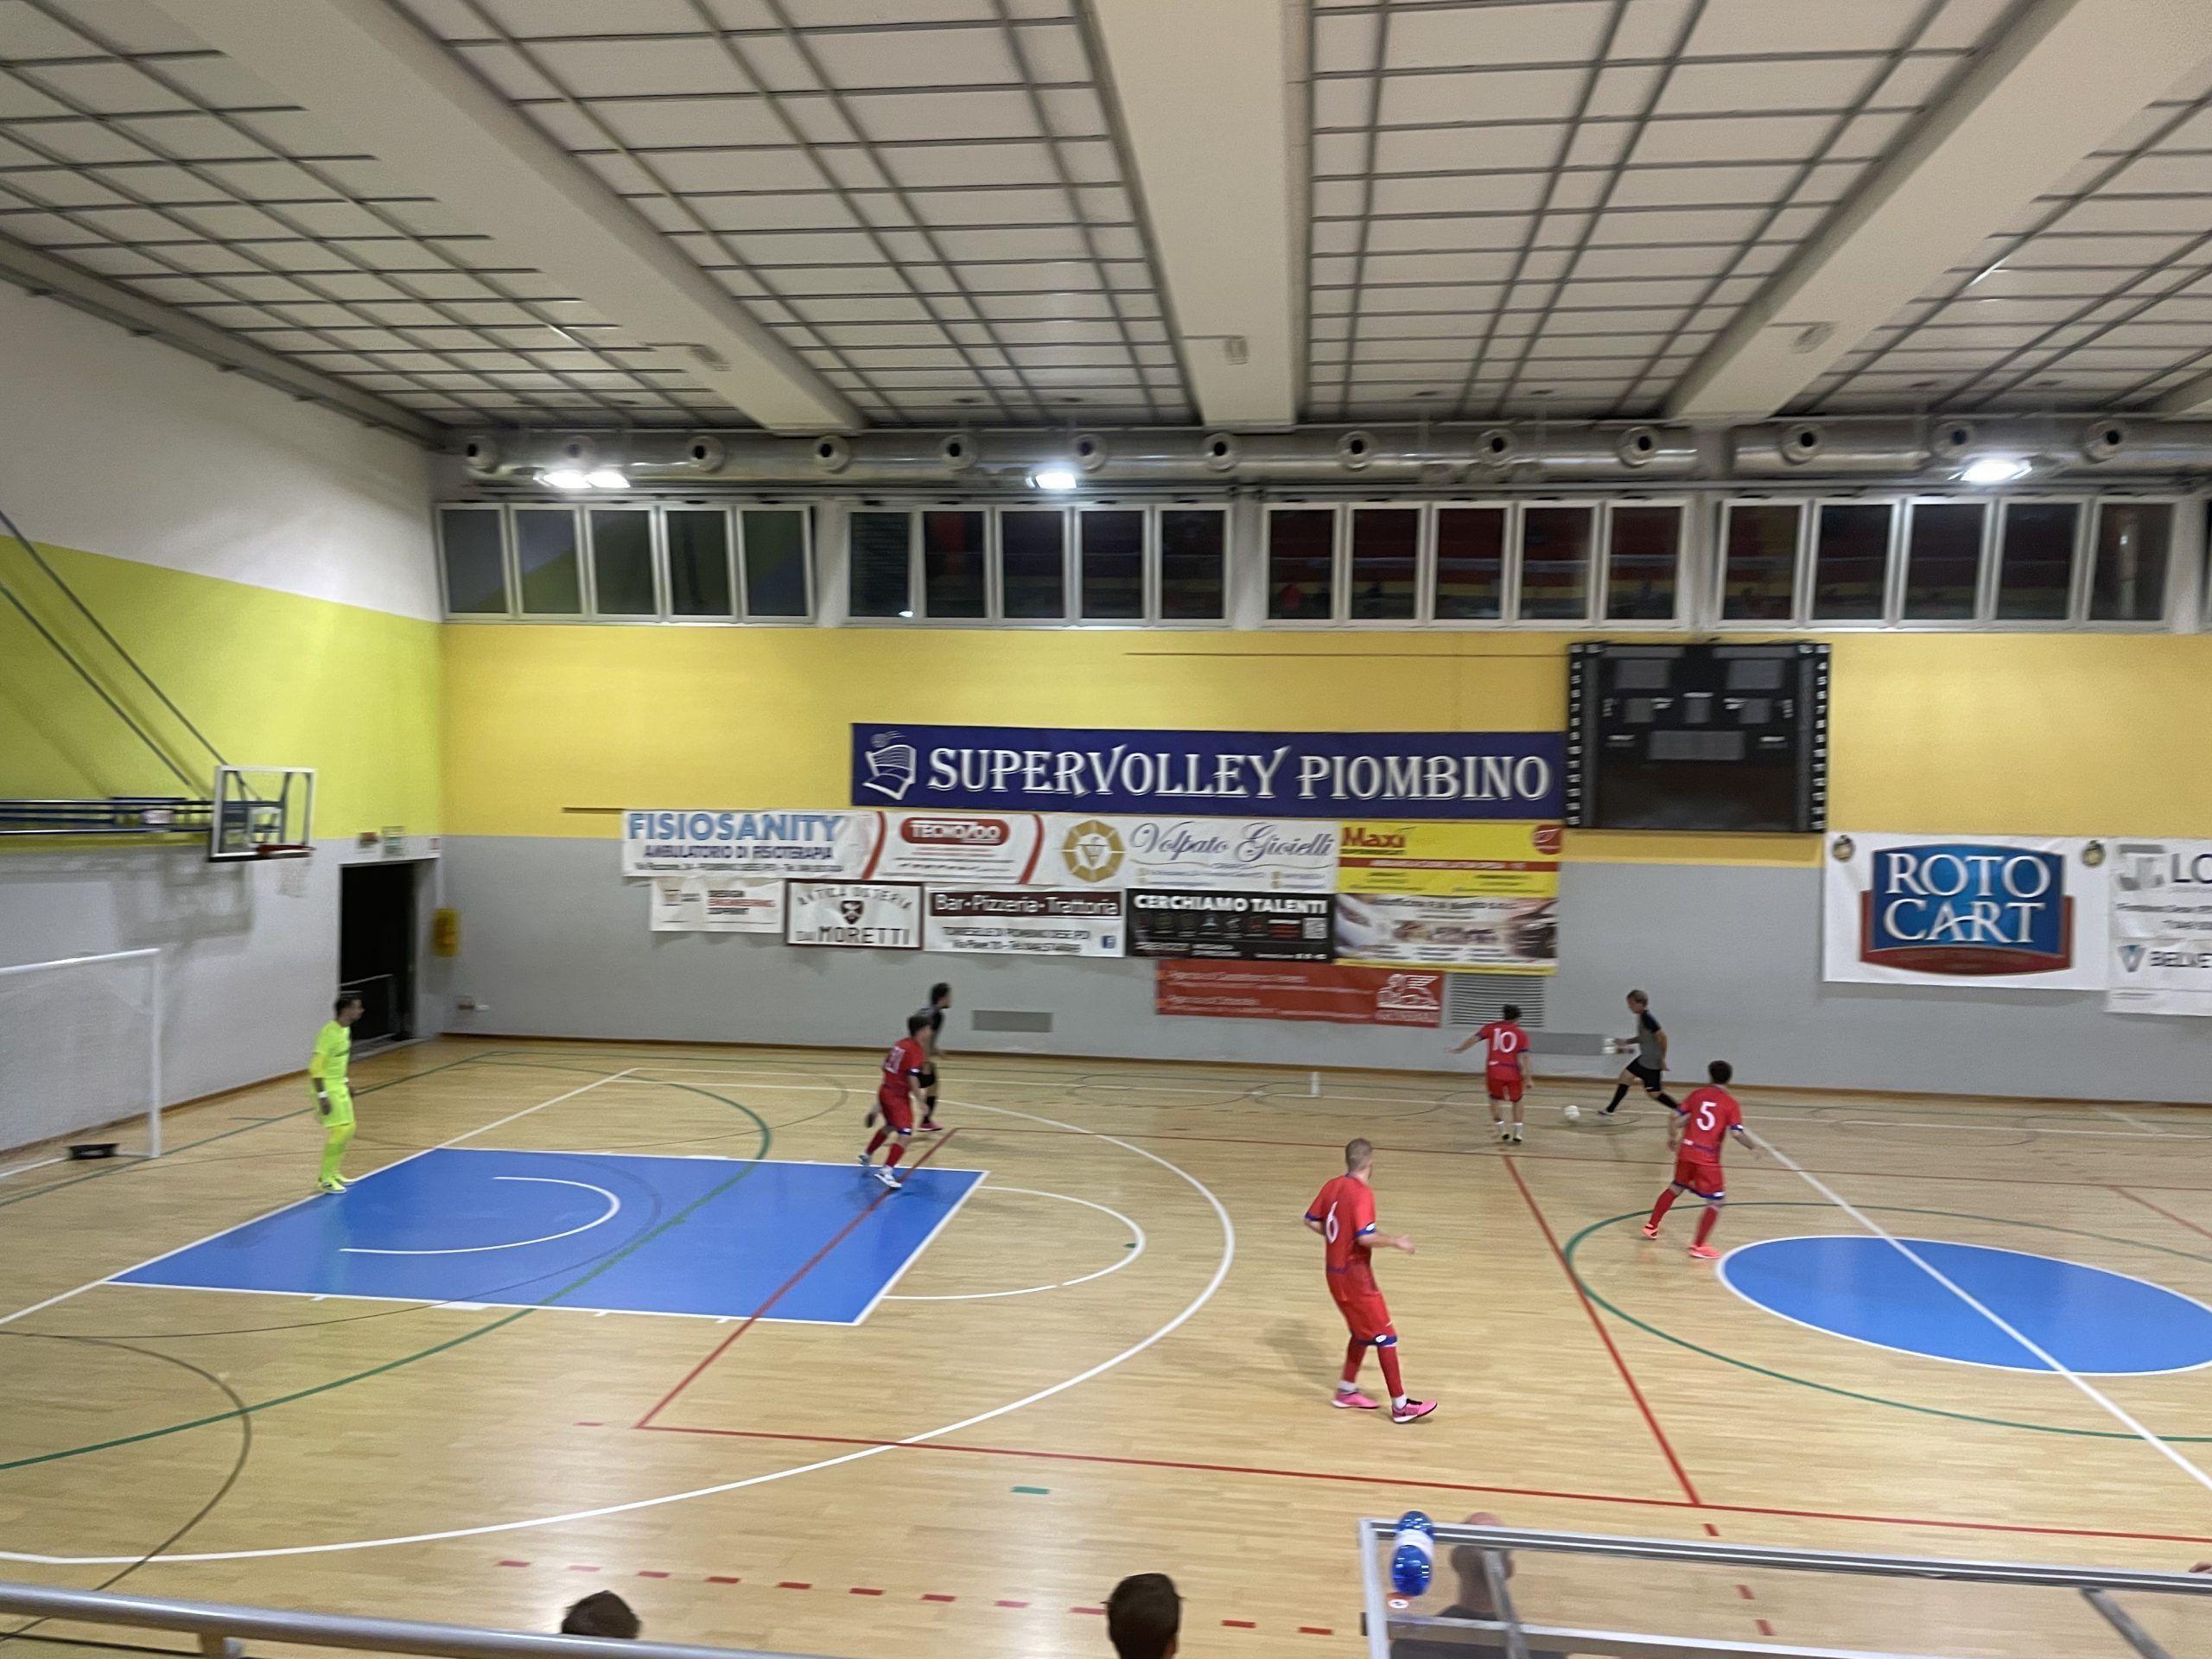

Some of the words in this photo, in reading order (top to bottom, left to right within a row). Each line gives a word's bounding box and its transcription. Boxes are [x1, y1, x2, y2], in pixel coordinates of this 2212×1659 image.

[927, 744, 1292, 798] SUPERVOLLEY
[1296, 753, 1553, 801] PIOMBINO
[629, 813, 844, 842] FISIOSANITY
[1130, 821, 1230, 860] Volpato
[1234, 822, 1335, 862] Gioielli
[1885, 852, 2051, 899] ROTO
[1134, 894, 1249, 912] CERCHIAMO
[1250, 898, 1328, 914] TALENTI
[1883, 898, 2047, 944] CART
[817, 926, 910, 945] MORETTI
[1493, 1027, 1516, 1053] 10
[1696, 1101, 1716, 1131] 5
[1325, 1201, 1339, 1244] 6
